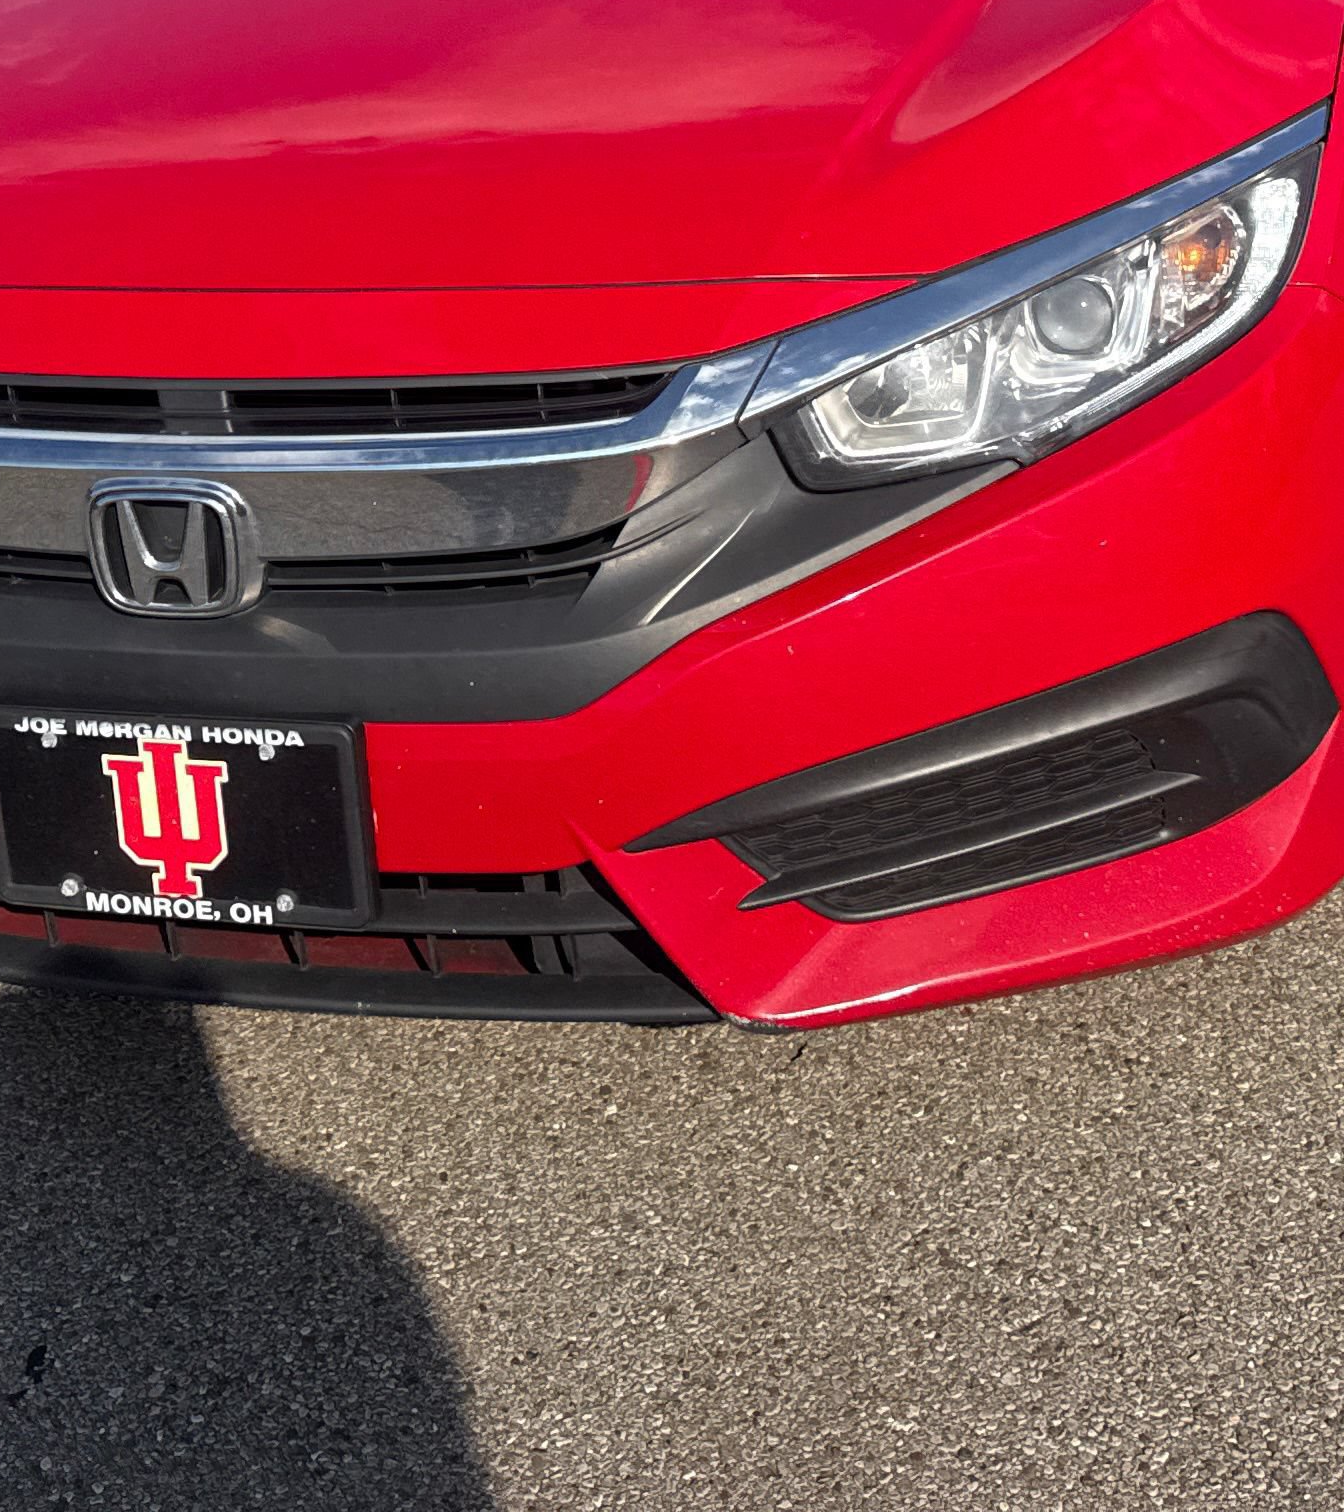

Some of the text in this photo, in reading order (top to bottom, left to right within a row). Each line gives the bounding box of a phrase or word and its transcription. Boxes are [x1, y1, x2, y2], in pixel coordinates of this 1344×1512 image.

[14, 716, 305, 747] JOE MORGAN HONDA
[86, 891, 274, 925] MONROE, OH
